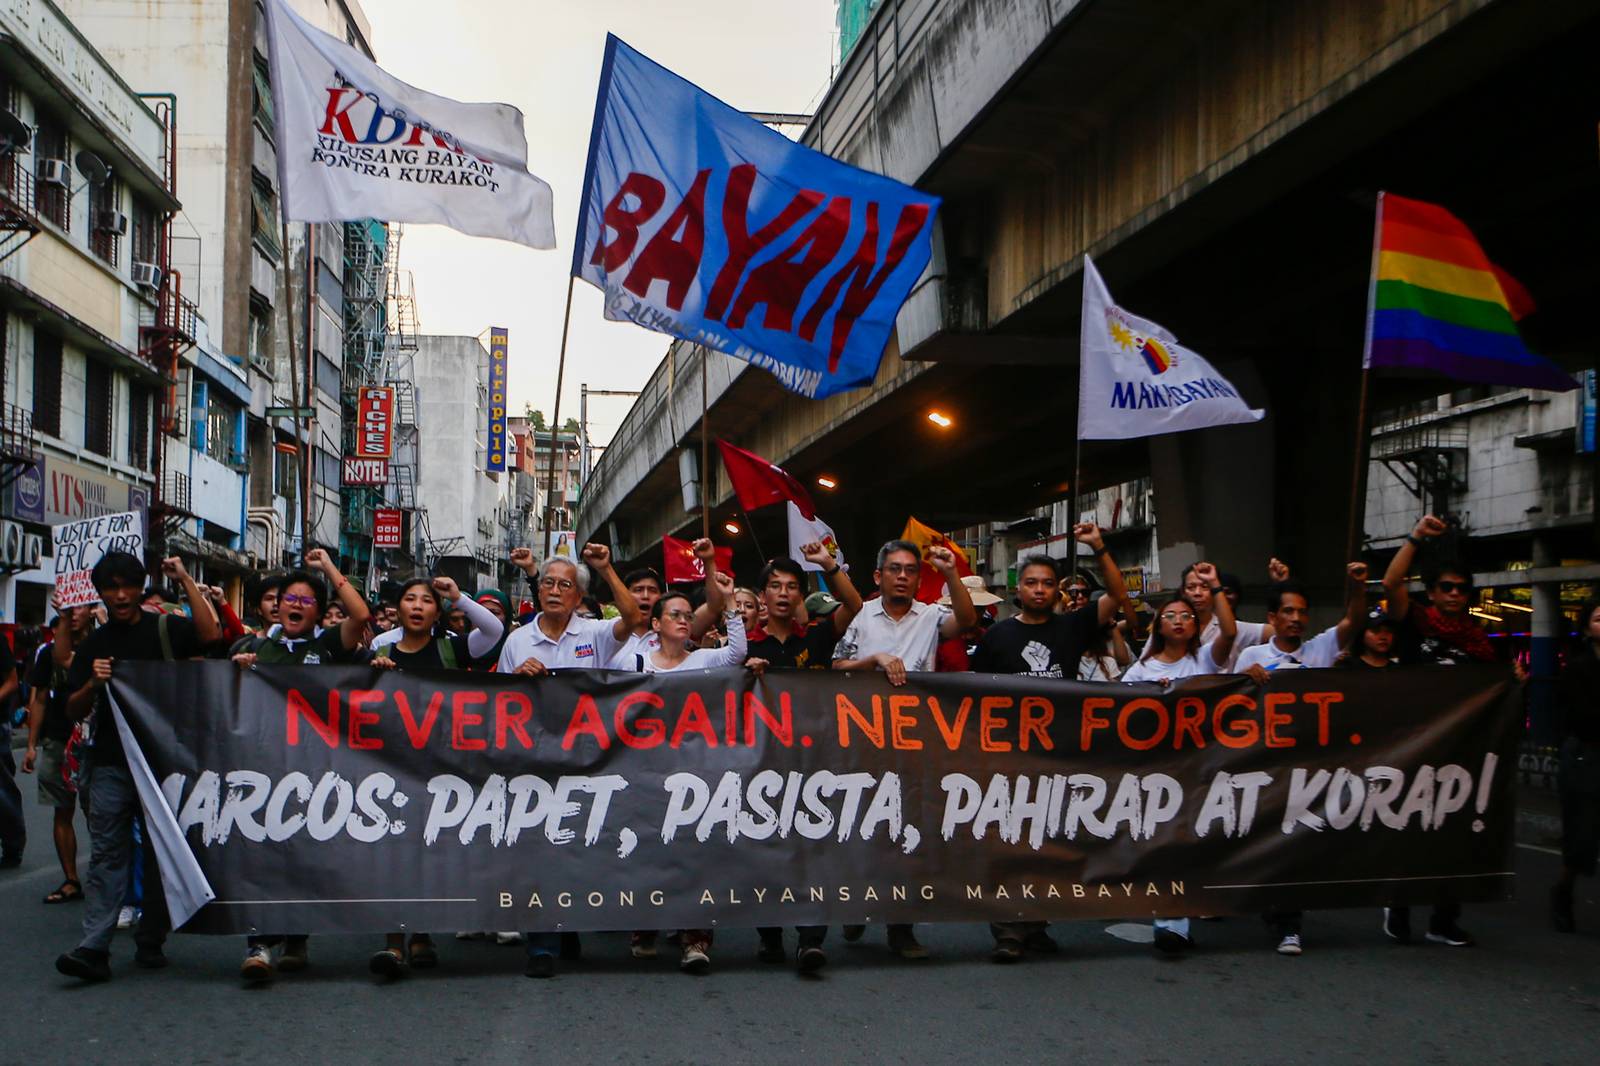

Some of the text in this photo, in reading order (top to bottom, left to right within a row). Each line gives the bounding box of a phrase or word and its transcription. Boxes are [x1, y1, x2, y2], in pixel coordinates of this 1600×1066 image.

[311, 148, 499, 193] KONTRA KURAKOT
[318, 134, 494, 177] KILUSANG BAYAN
[590, 163, 929, 373] BAYAN
[491, 334, 507, 464] metropole
[1111, 377, 1237, 410] MAKABAYAN
[365, 390, 386, 453] RICHES
[84, 479, 107, 505] HOME
[344, 460, 387, 483] HOTEL
[47, 470, 84, 519] ATS
[55, 514, 133, 545] JUSTICE FOR
[55, 540, 94, 574] ERIC
[285, 689, 1361, 752] NEVER AGAIN. NEVER FORGET.
[423, 772, 638, 859] PAPET,
[661, 769, 921, 854] PASISTA,
[940, 772, 1183, 850] PAHIRAP
[1195, 770, 1273, 838] AT
[1281, 752, 1498, 834] KORAP!
[500, 880, 1185, 908] BAGONG ALYANSANG MAKABAYAN
